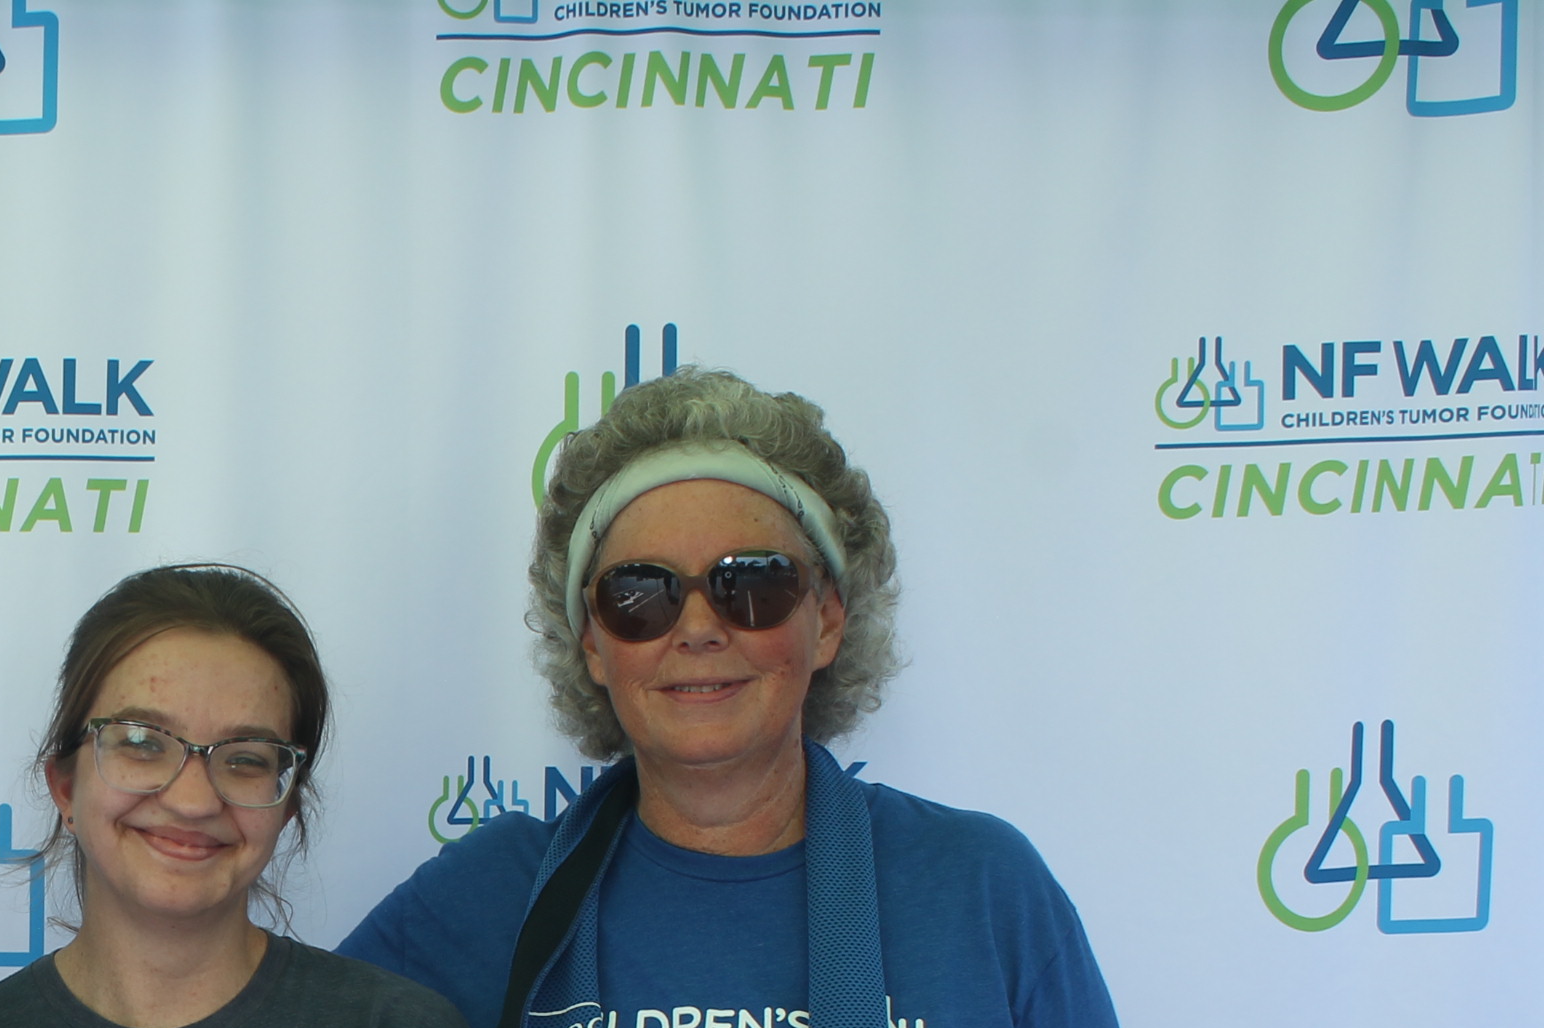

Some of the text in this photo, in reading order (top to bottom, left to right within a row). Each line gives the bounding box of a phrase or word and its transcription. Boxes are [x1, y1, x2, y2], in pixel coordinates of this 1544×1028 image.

[554, 1, 882, 22] CHILDREN'S TUMOR FOUNDATION
[440, 50, 875, 114] CINCINNATI
[1281, 340, 1382, 400] NF
[1281, 409, 1395, 429] CHILDREN'S
[1399, 406, 1470, 426] TUMOR
[22, 427, 157, 446] FOUNDATION
